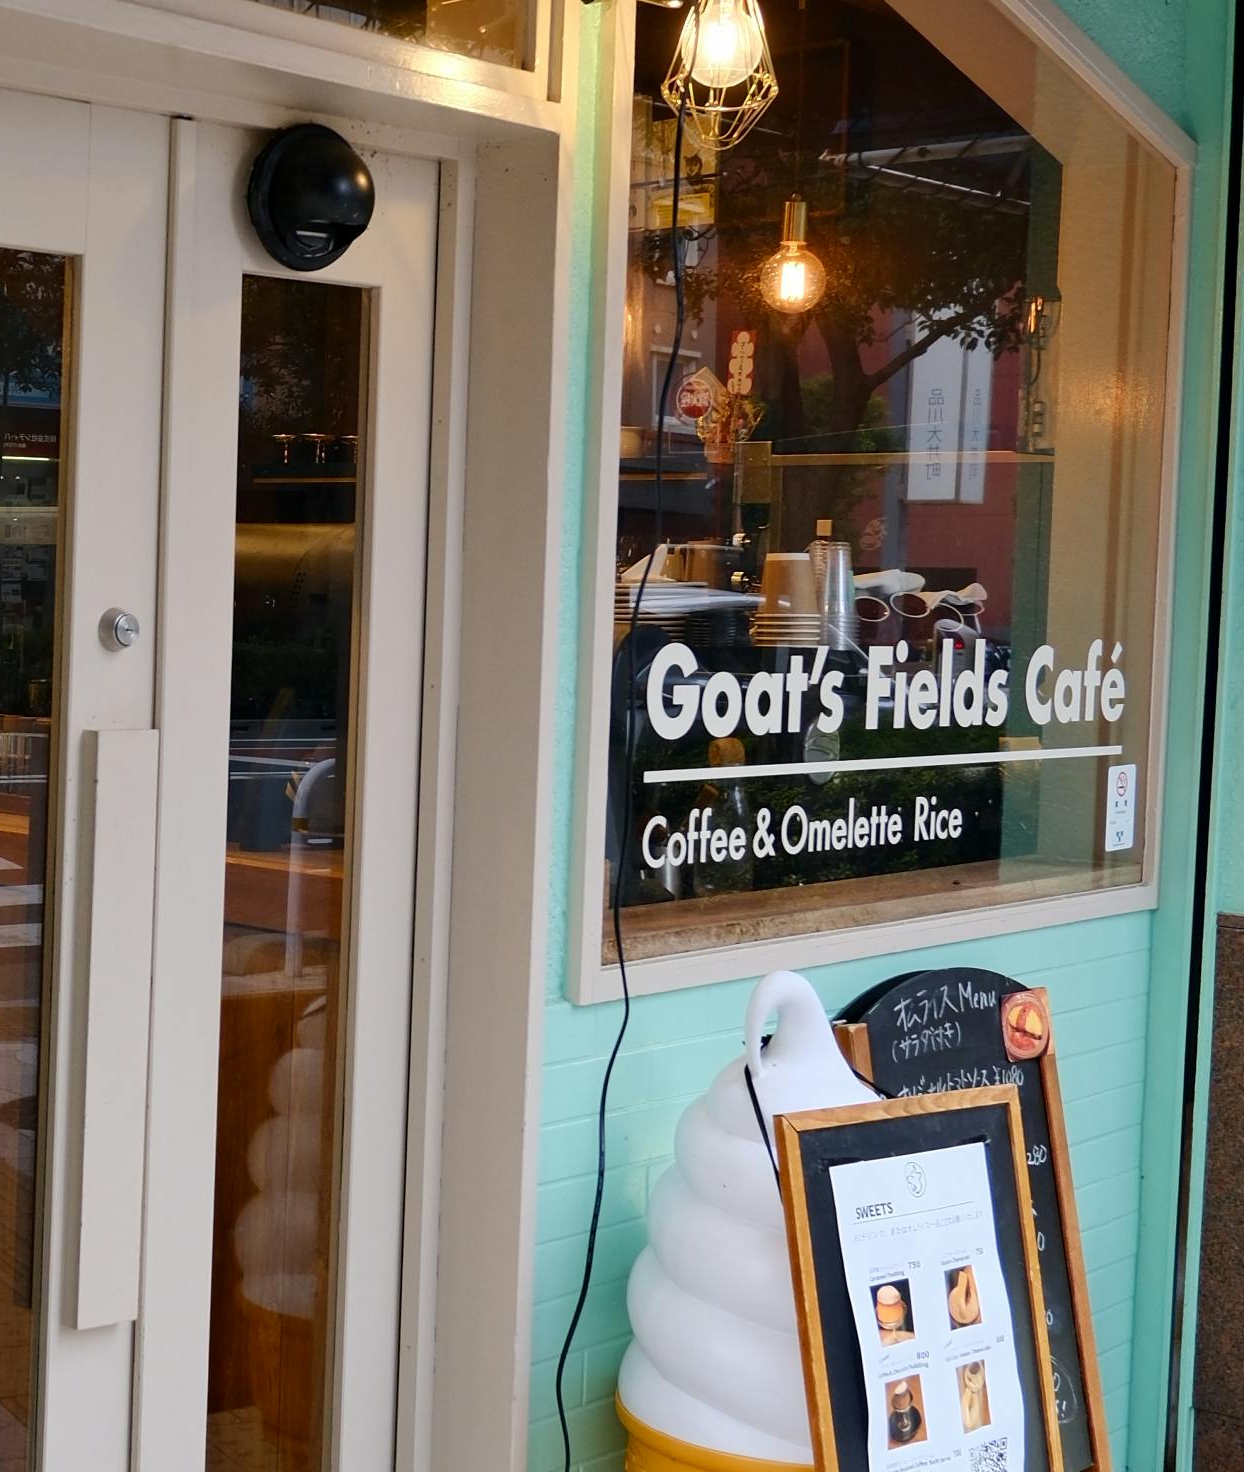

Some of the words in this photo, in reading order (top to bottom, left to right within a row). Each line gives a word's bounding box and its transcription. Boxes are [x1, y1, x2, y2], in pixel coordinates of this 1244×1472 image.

[645, 642, 845, 740] Goat's
[865, 638, 1010, 730] Fields
[1024, 638, 1126, 725] Café
[913, 795, 963, 842] Rice
[958, 981, 997, 1013] Menu
[855, 1202, 894, 1220] SWEETS
